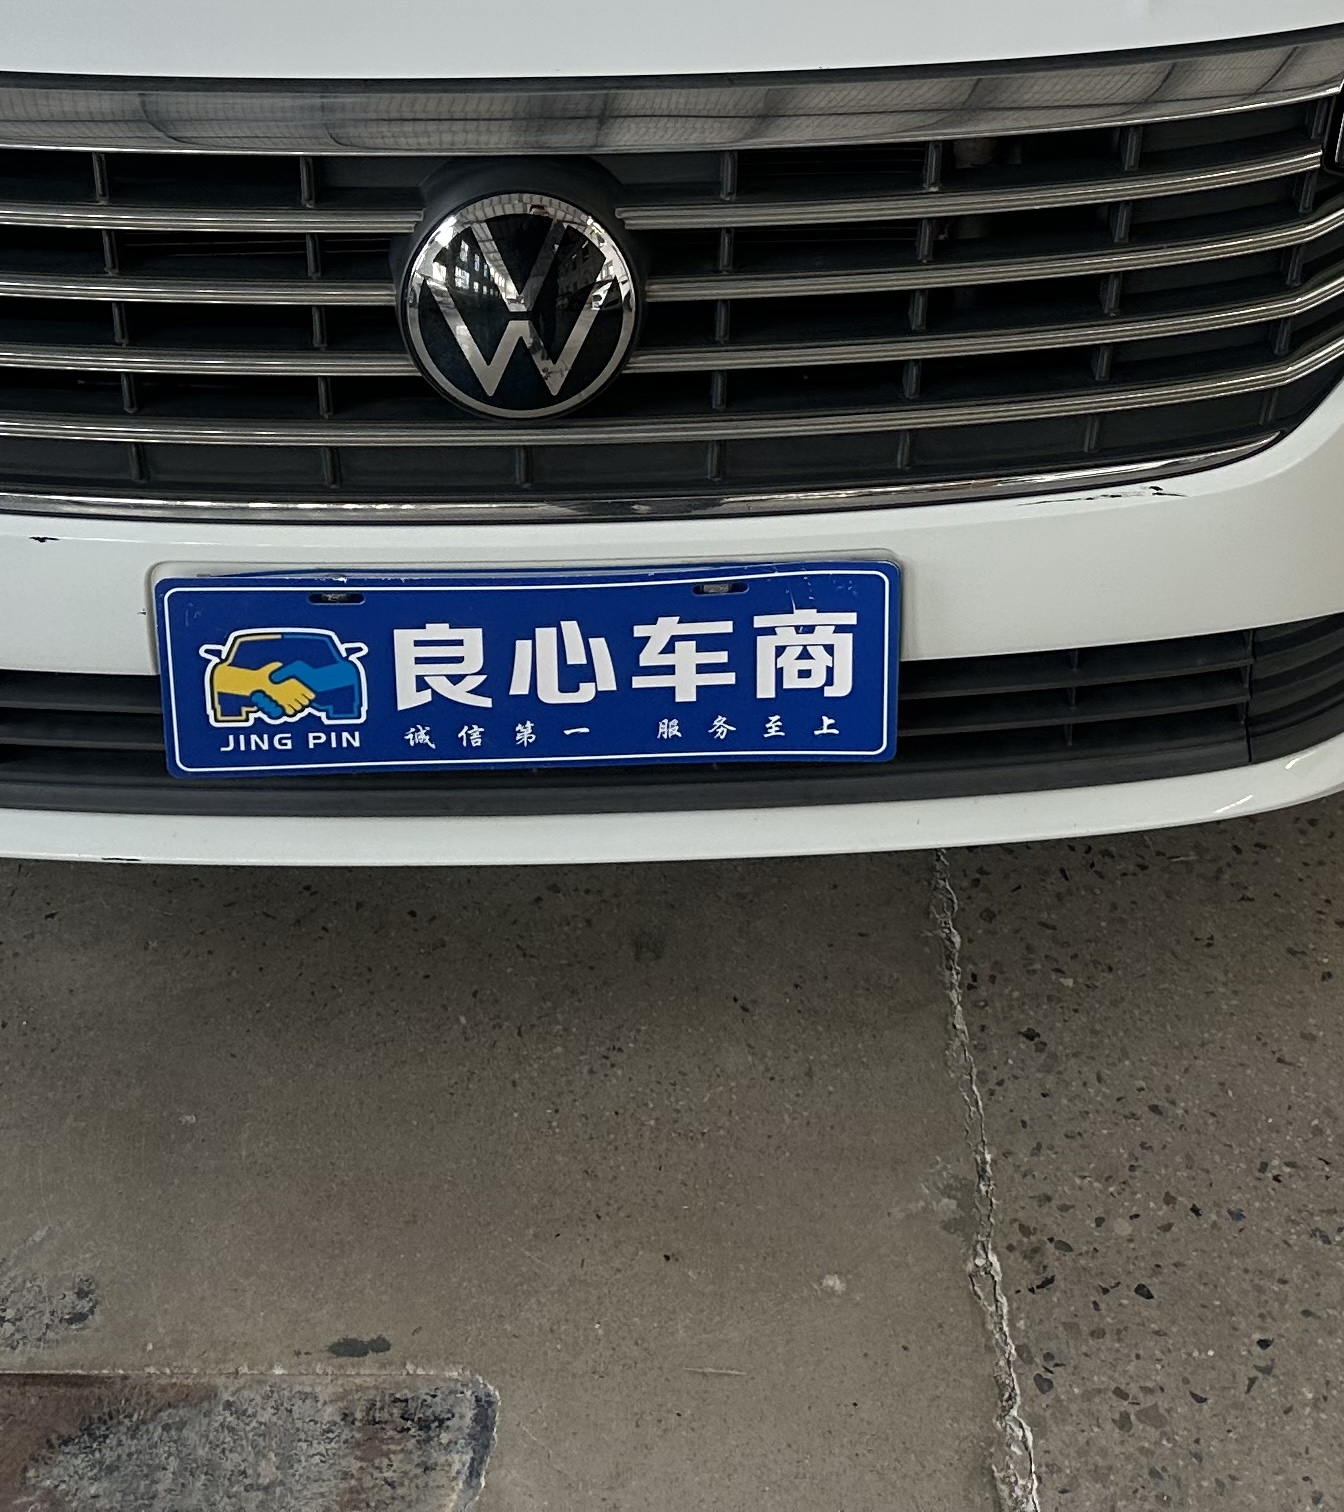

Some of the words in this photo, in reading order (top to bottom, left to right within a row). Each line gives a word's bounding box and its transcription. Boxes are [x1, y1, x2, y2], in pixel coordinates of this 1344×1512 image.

[394, 608, 857, 710] 良心车商
[221, 734, 292, 751] JING
[308, 732, 360, 748] PIN
[404, 721, 589, 748] 诚信第一
[657, 715, 839, 739] 服务至上
